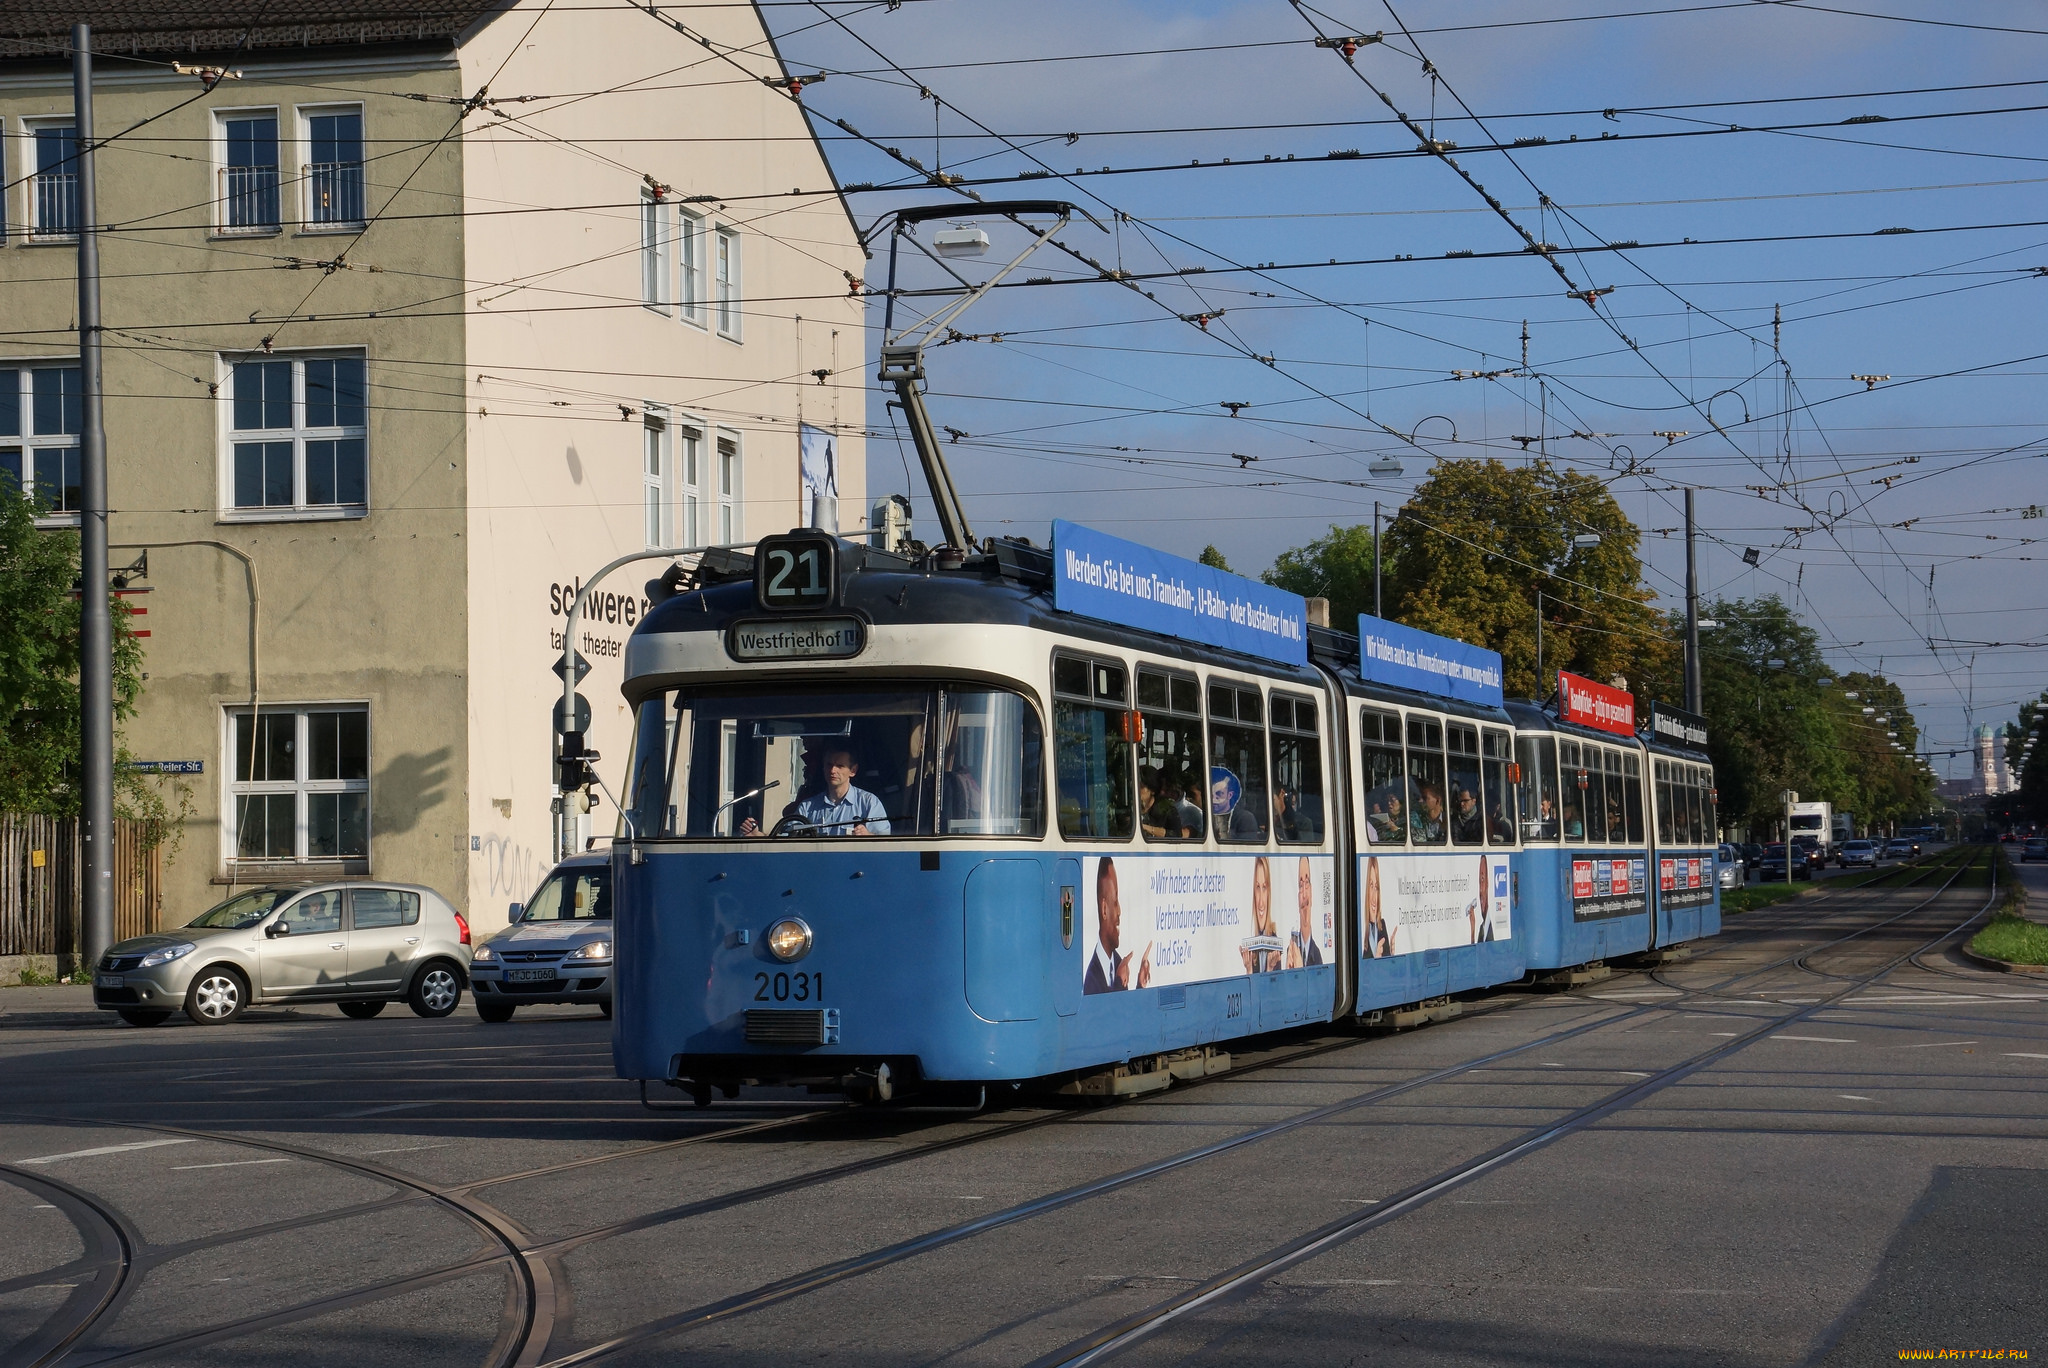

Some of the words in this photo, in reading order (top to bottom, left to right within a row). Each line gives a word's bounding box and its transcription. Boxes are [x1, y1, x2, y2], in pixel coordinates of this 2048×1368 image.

[2022, 509, 2043, 520] 251
[768, 549, 828, 596] 21
[550, 576, 636, 627] schwere
[1065, 549, 1102, 587] Werden
[1103, 560, 1118, 592] Sie
[1119, 563, 1134, 595] bei
[1136, 575, 1151, 600] uns
[1198, 587, 1229, 620] U-Bahn-
[1230, 597, 1246, 625] oder
[1247, 602, 1280, 634] Busfahrer
[1280, 610, 1301, 642] (m/w).
[583, 632, 622, 658] theater
[741, 631, 841, 650] Westfriedhof
[1366, 634, 1376, 658] Wir
[1377, 636, 1394, 662] bilden
[1394, 643, 1406, 666] auch
[1407, 650, 1417, 668] aus.
[1416, 648, 1448, 676] Informationen
[1448, 659, 1462, 679] unter:
[1150, 868, 1168, 894] »Wir
[1168, 868, 1191, 894] haben
[1192, 867, 1203, 893] die
[1204, 867, 1226, 893] besten
[1156, 903, 1204, 935] Verbindungen
[1206, 901, 1240, 927] Münchens.
[1156, 939, 1171, 967] Und
[509, 971, 515, 980] M
[520, 971, 531, 980] JC
[532, 969, 554, 980] 1060
[754, 971, 823, 1002] 2031
[1227, 993, 1242, 1019] 2031
